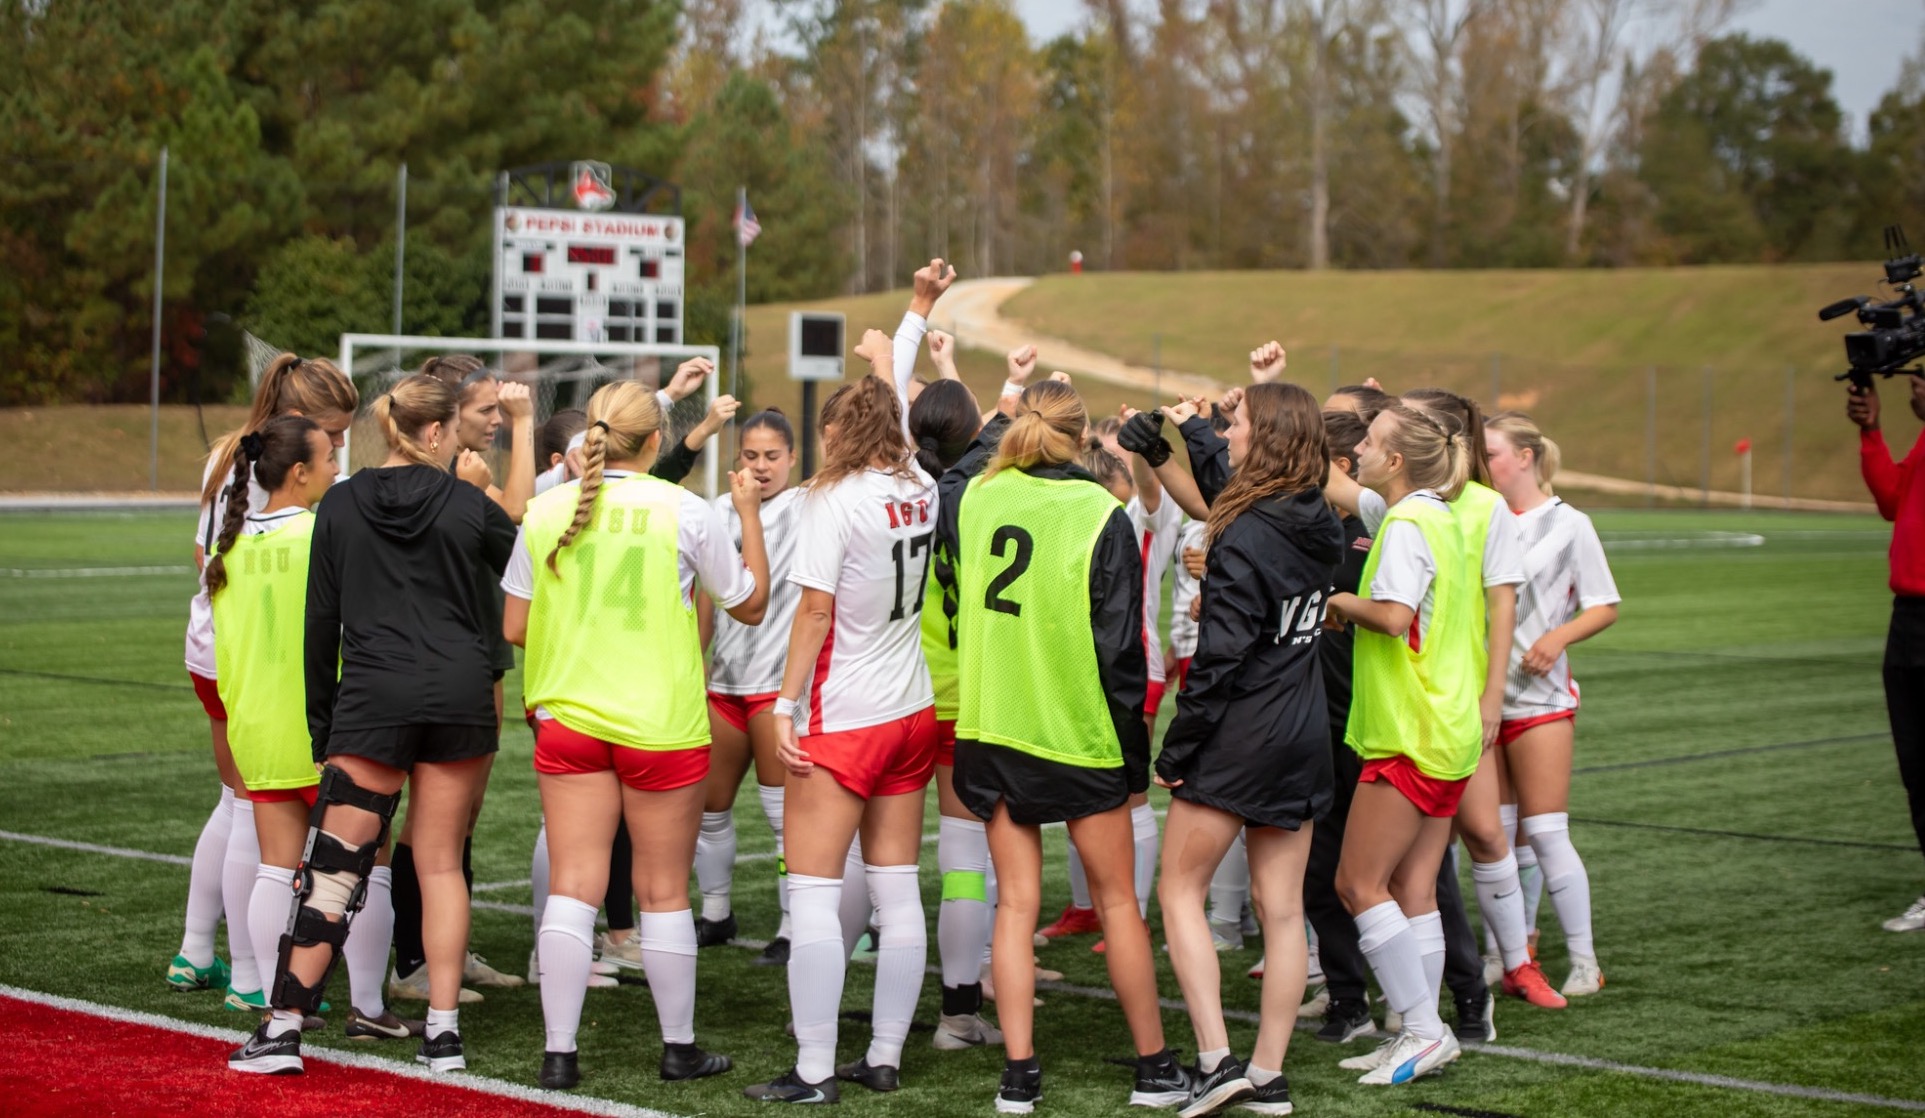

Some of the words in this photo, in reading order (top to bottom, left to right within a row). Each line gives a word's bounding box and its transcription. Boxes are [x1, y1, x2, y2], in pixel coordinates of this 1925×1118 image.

[525, 217, 575, 233] PEPSI
[582, 219, 659, 237] STADIUM
[243, 547, 290, 575] NGU
[576, 543, 647, 632] 14
[889, 531, 932, 622] 17
[985, 525, 1034, 618] 2
